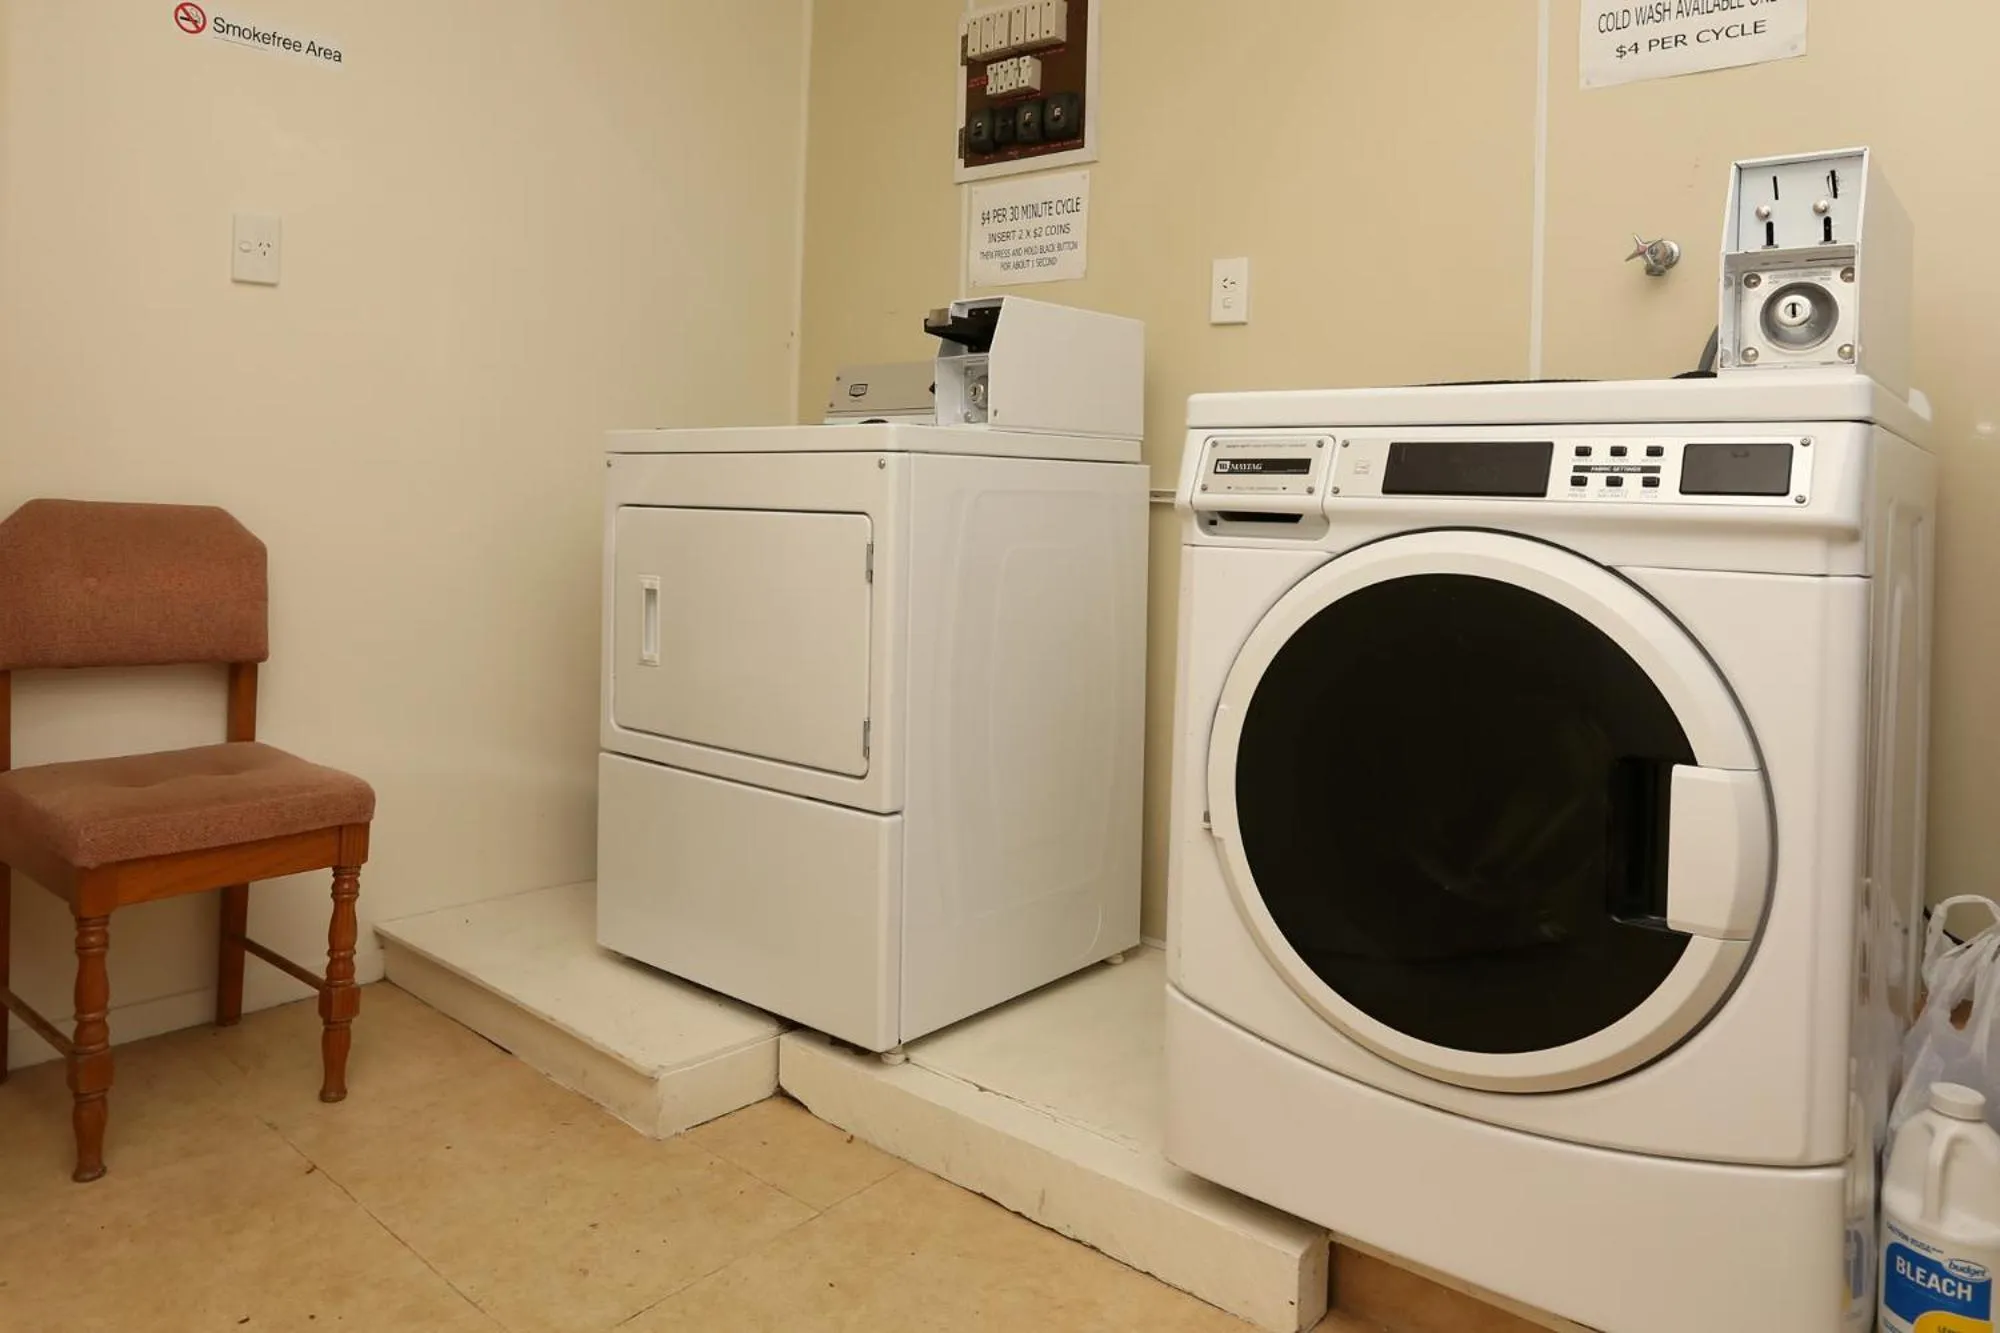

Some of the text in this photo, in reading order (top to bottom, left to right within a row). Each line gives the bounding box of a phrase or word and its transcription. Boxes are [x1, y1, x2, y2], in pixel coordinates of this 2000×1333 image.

[1598, 9, 1631, 33] COLD
[1635, 2, 1671, 27] WASH
[213, 16, 342, 62] Smokefree Area
[1615, 20, 1767, 58] $4 PER CYCLE
[981, 197, 1081, 226] $4 PER 30 MINUTE CYCLE
[988, 230, 1016, 244] INSERT
[1018, 229, 1024, 240] 2
[1033, 227, 1043, 238] $2
[1045, 223, 1071, 236] COINS
[980, 241, 1078, 260] THEN PRESS AND HOLD BLACK BUTTON
[1001, 261, 1011, 270] FOR
[1012, 259, 1030, 270] ABOUT
[1036, 257, 1058, 268] SECOND
[1896, 1254, 1972, 1302] BLEACH
[1948, 1259, 1986, 1276] budget
